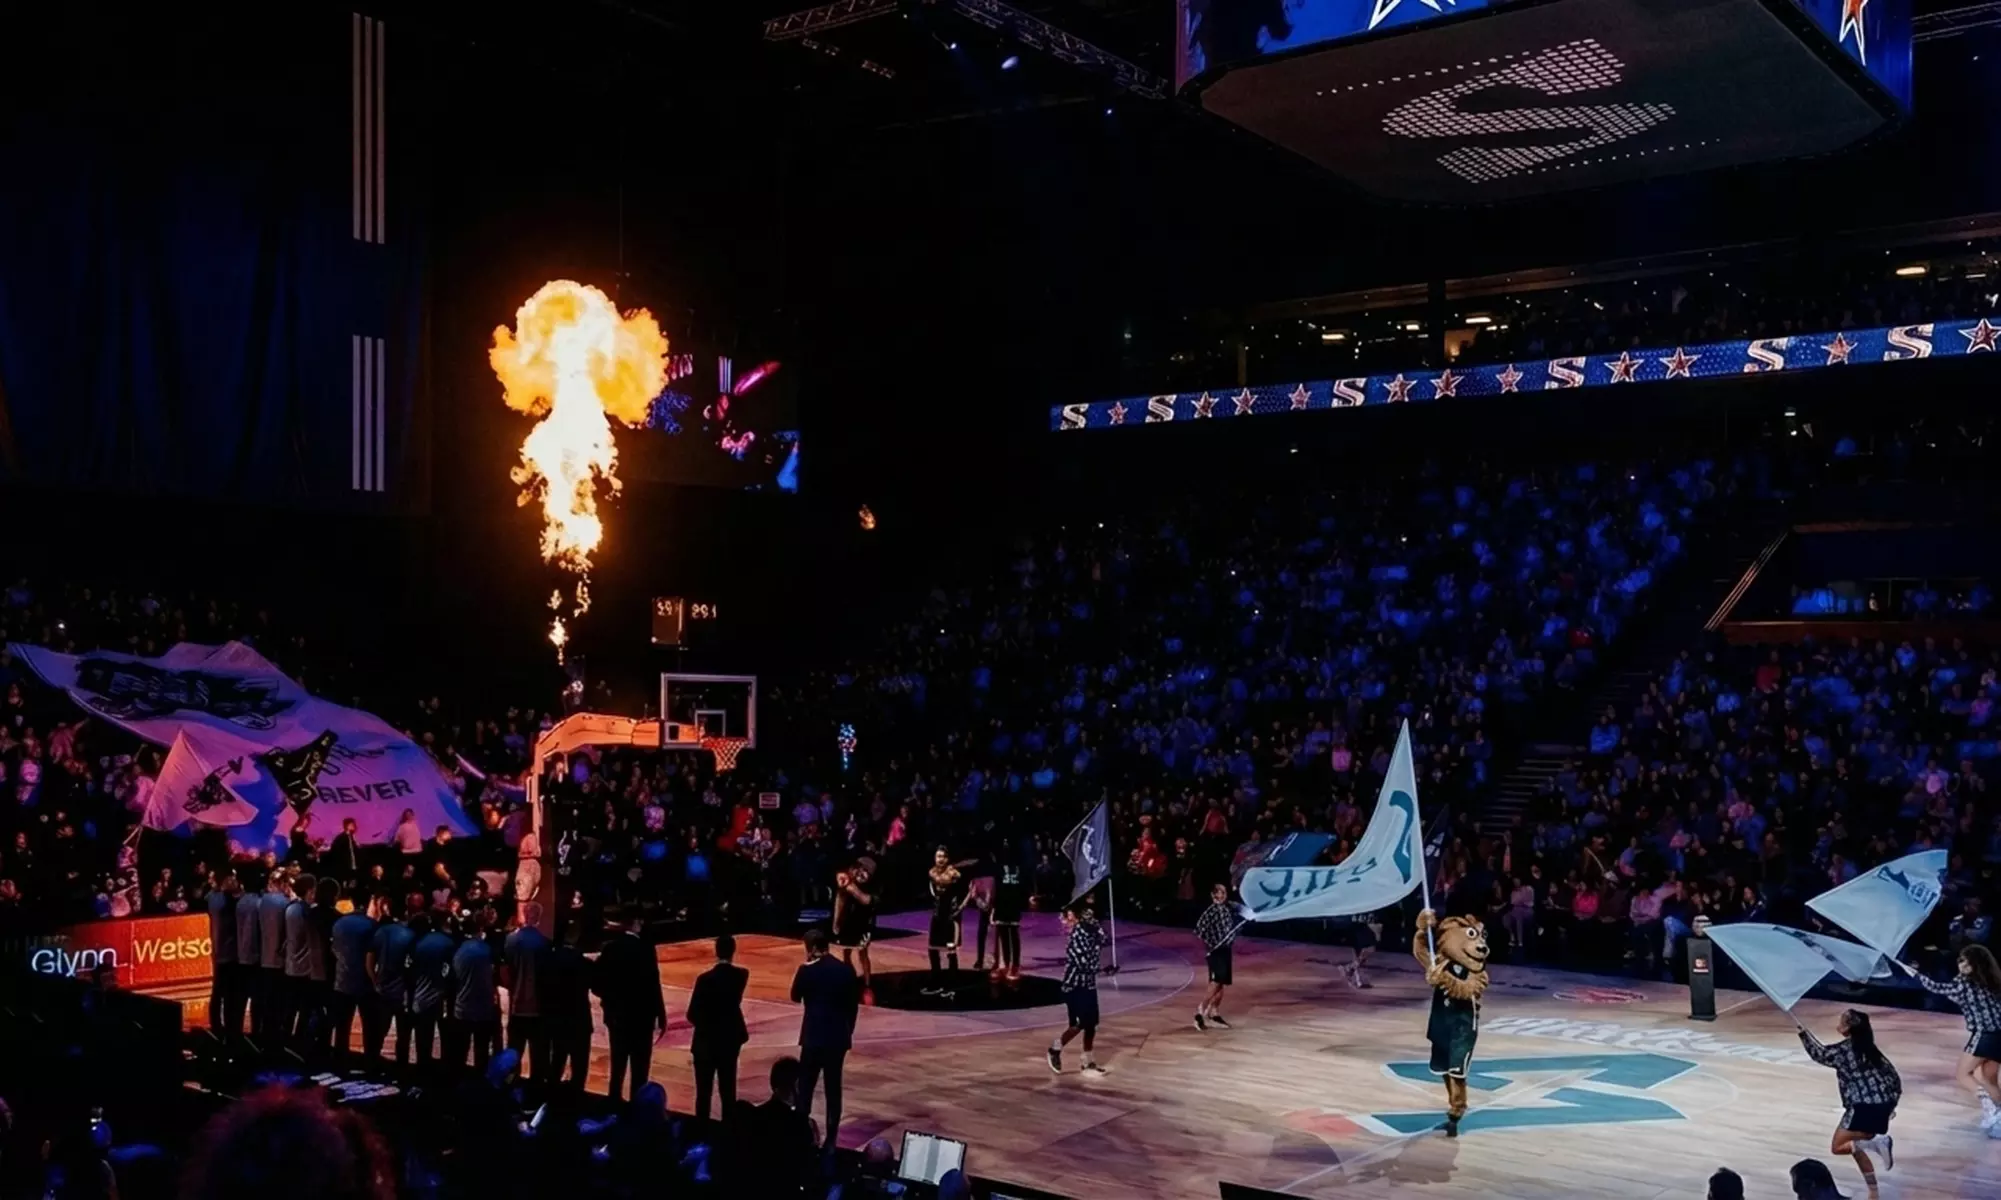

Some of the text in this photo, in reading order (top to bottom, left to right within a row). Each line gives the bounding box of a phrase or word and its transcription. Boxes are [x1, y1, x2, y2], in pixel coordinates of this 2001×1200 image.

[1060, 322, 1934, 430] S S S S S S
[316, 779, 415, 804] REVER
